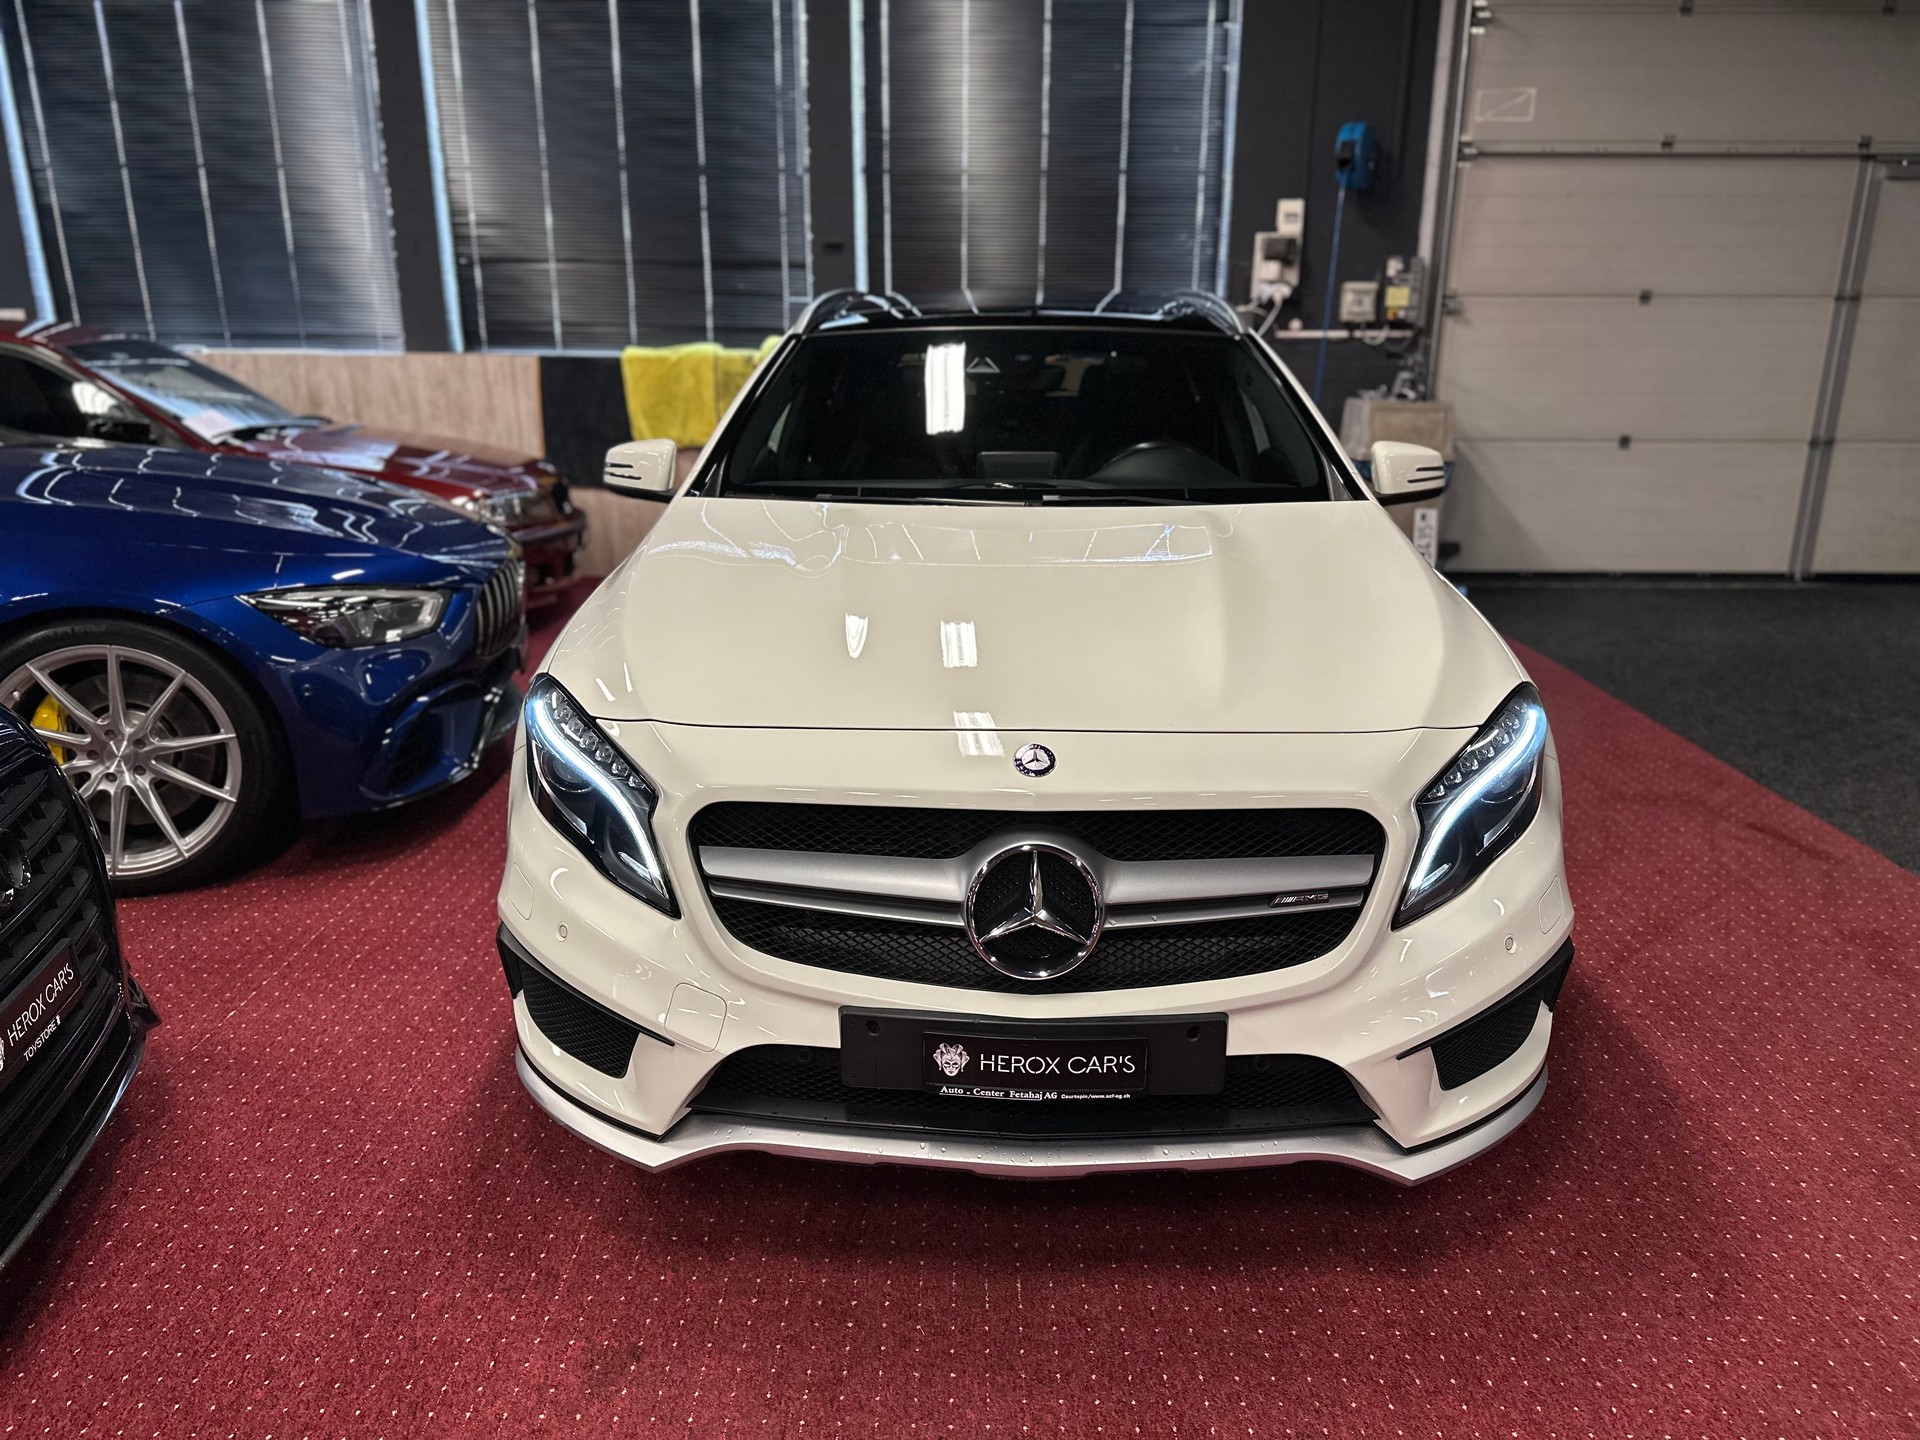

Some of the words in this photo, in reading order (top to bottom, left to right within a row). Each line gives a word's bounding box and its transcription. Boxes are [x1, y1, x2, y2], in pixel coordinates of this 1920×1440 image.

[7, 993, 47, 1047] HEROX
[45, 962, 74, 1003] CAR'S
[23, 1019, 58, 1062] TOYSTORE
[980, 1053, 1061, 1075] HEROX
[1067, 1055, 1136, 1074] CAR'S
[940, 1085, 964, 1095] Auto
[973, 1087, 1005, 1097] Center
[1009, 1090, 1043, 1101] Fetahaj
[1043, 1091, 1058, 1100] AG
